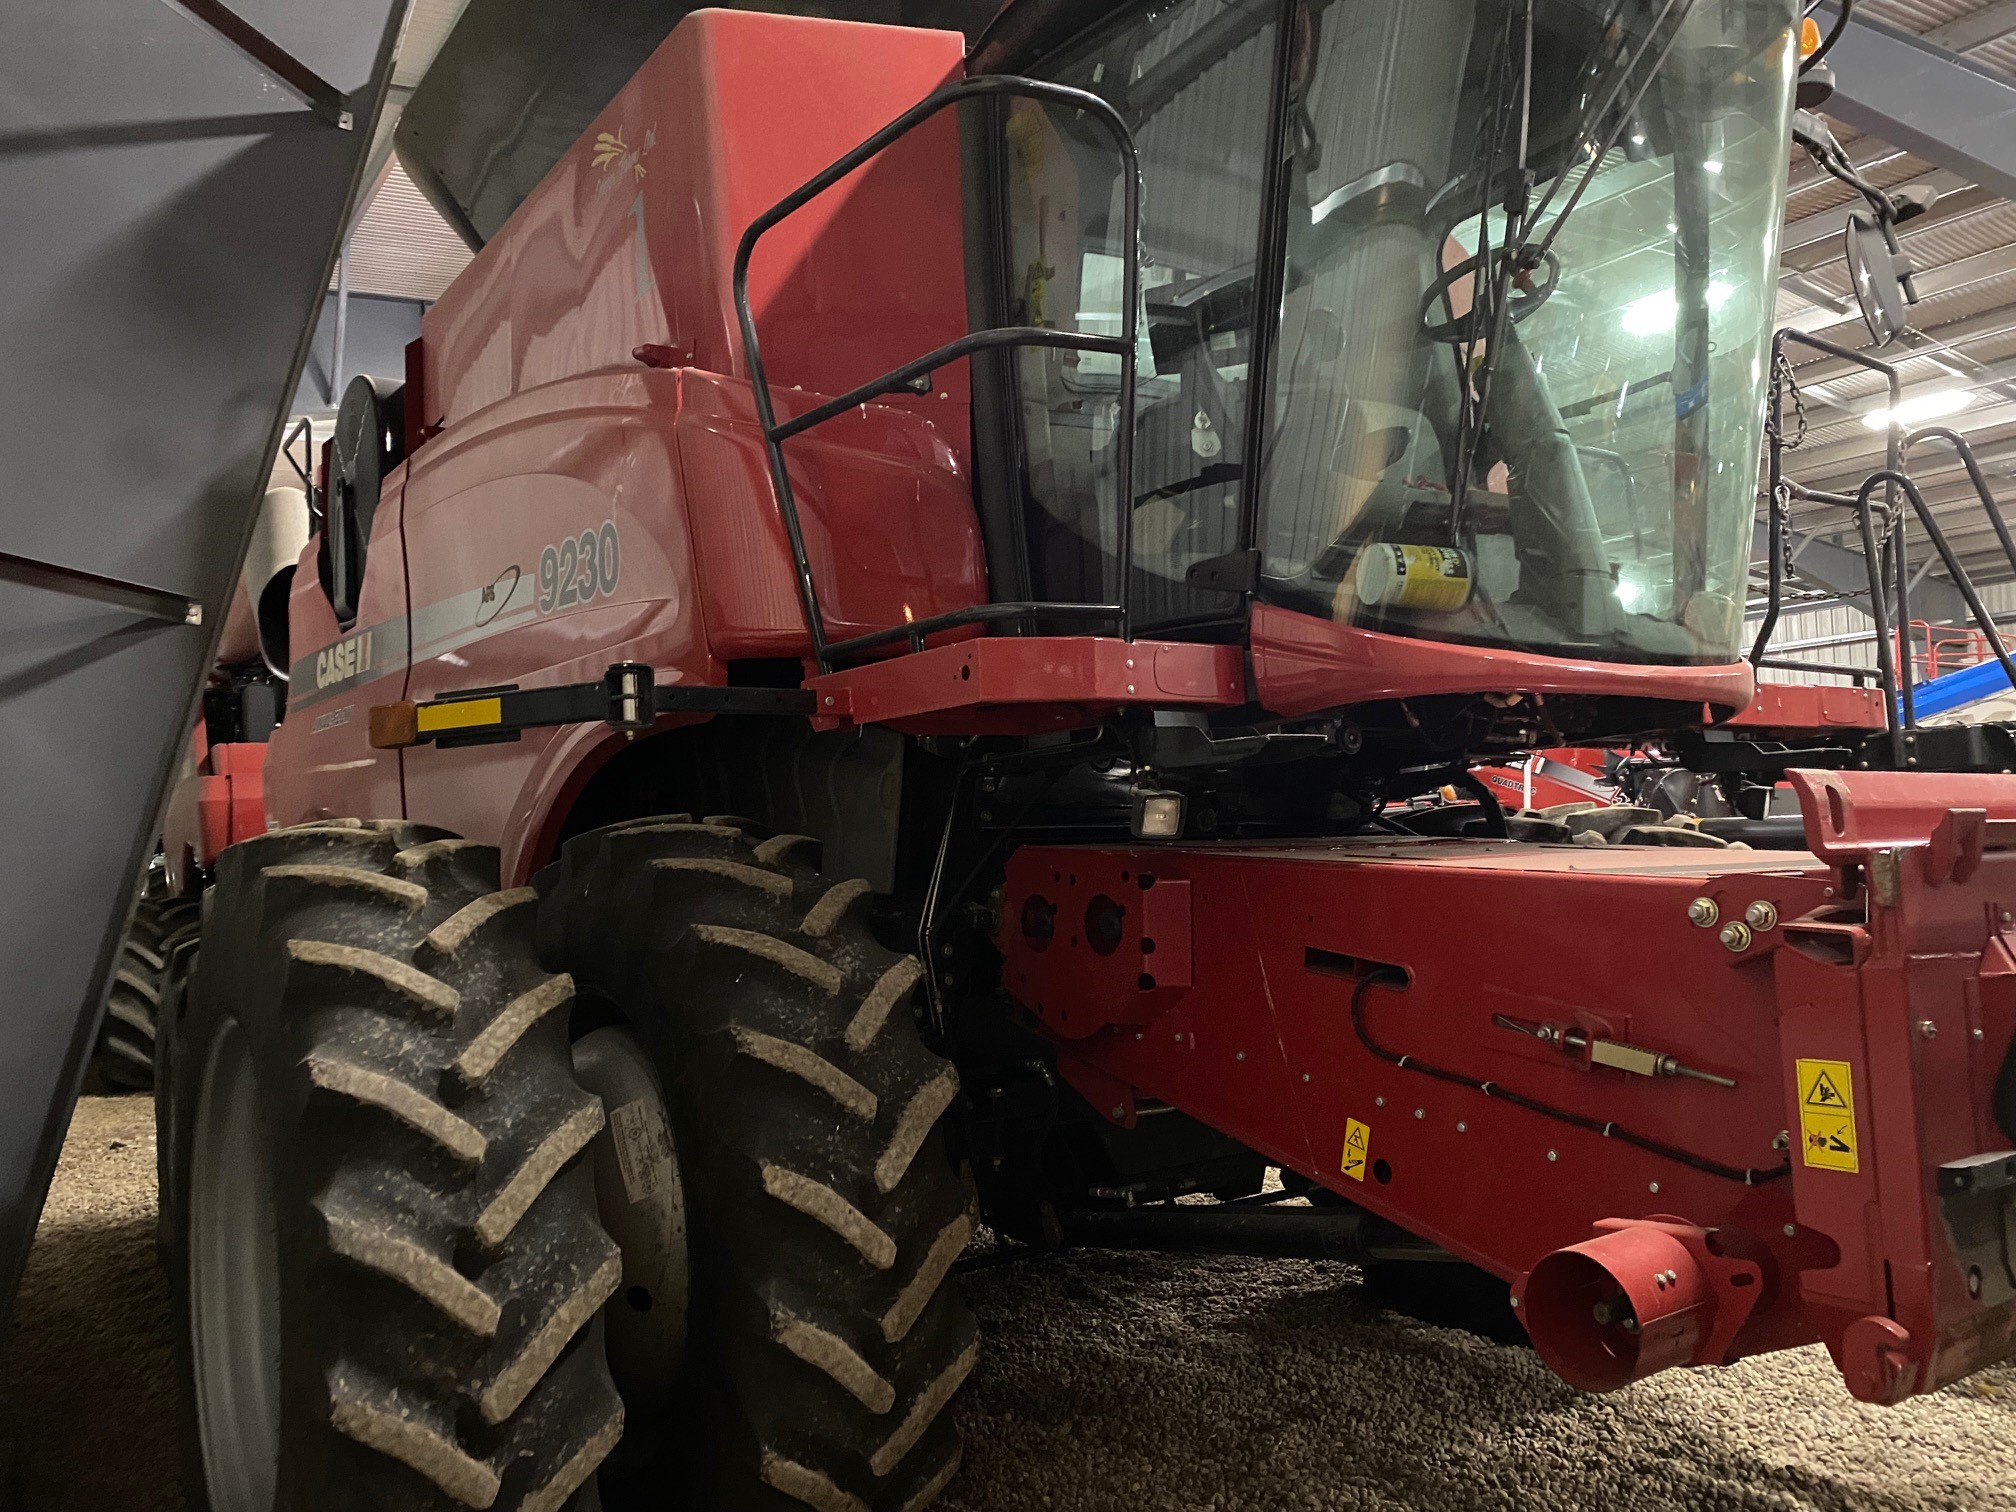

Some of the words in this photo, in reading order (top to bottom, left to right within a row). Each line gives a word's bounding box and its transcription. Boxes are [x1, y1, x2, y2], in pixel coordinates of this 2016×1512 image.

[538, 518, 621, 615] 9230
[316, 637, 356, 690] CASE
[1491, 775, 1538, 797] QUADTRC
